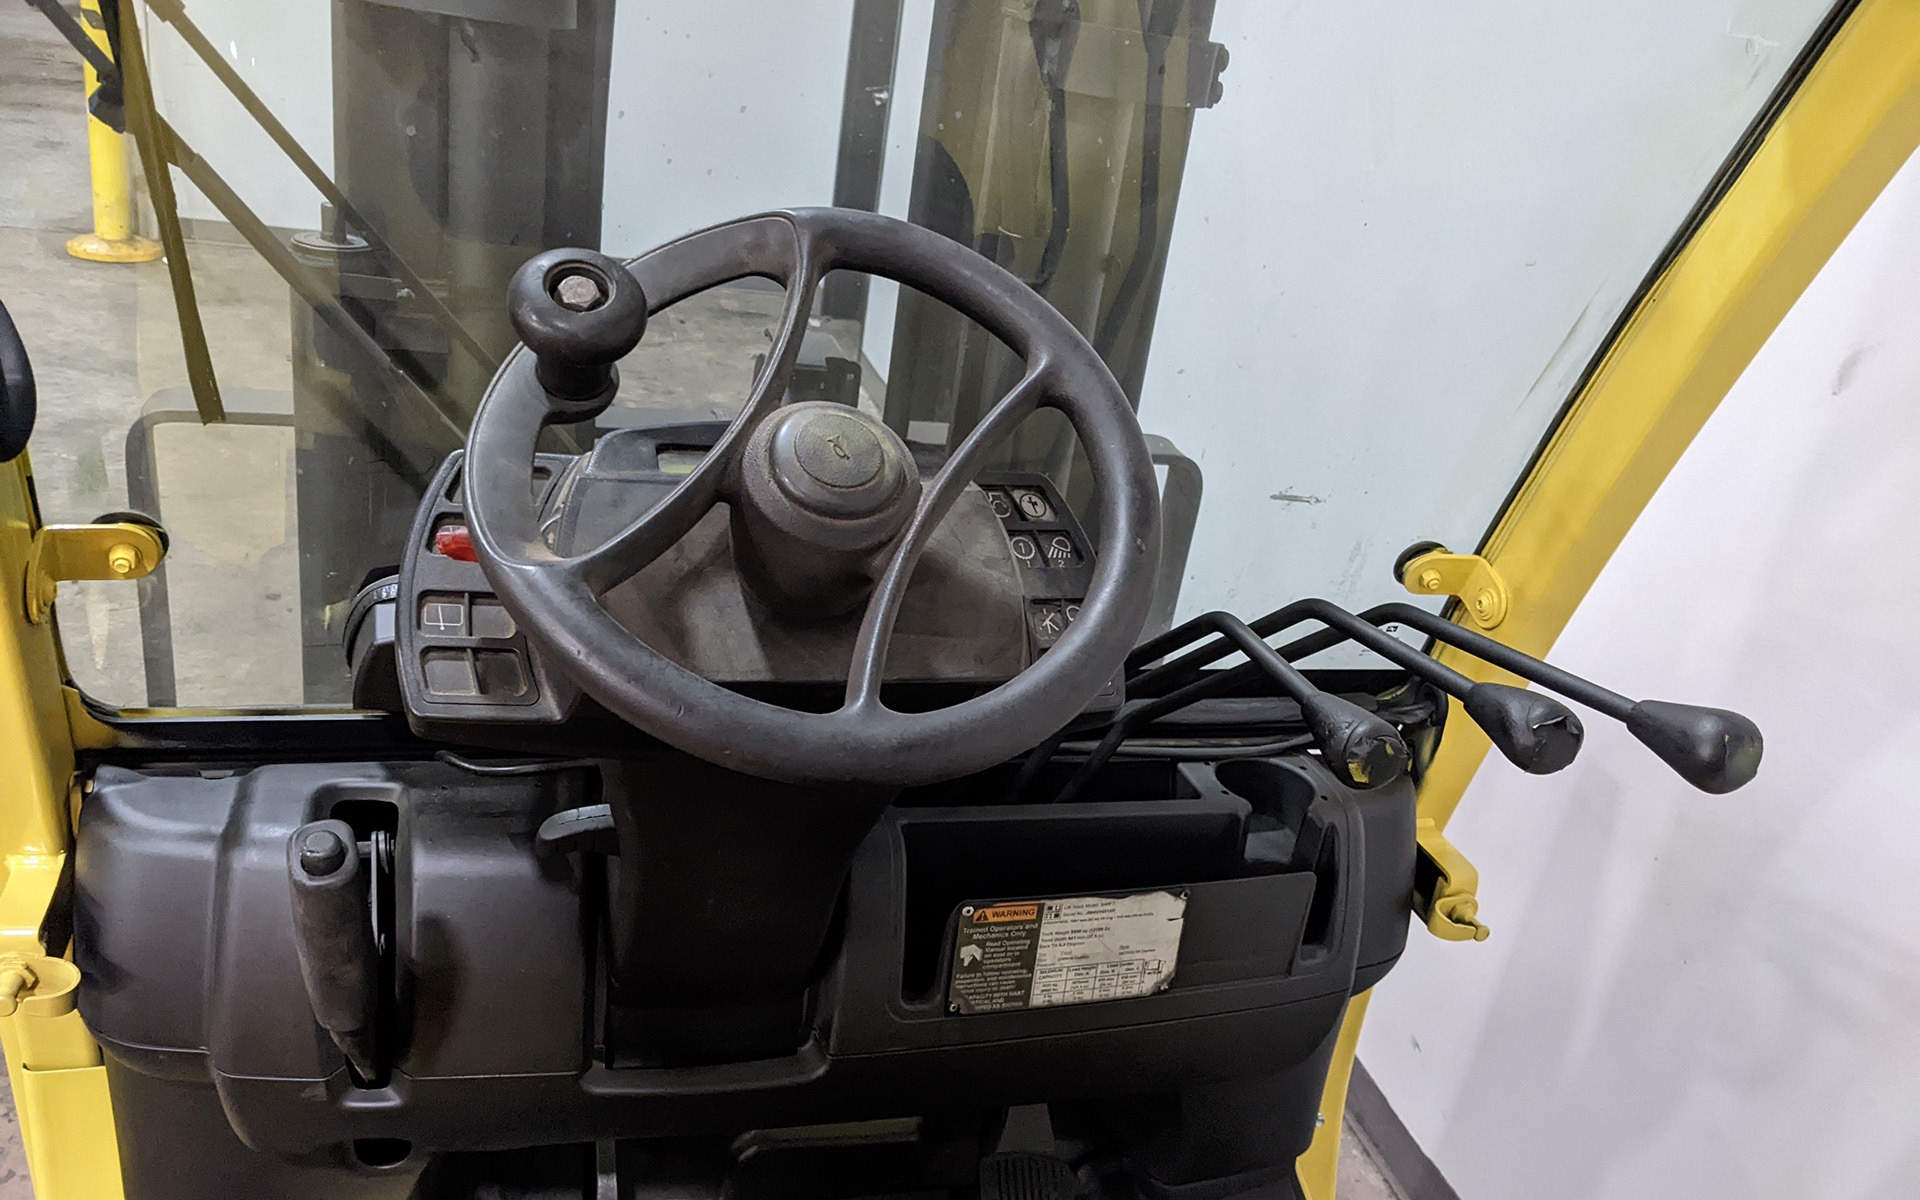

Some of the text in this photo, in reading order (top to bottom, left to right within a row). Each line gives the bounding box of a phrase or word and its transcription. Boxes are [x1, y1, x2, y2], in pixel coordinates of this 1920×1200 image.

[1058, 560, 1064, 568] 2
[992, 909, 1035, 918] WARNING
[990, 924, 1024, 932] Operators
